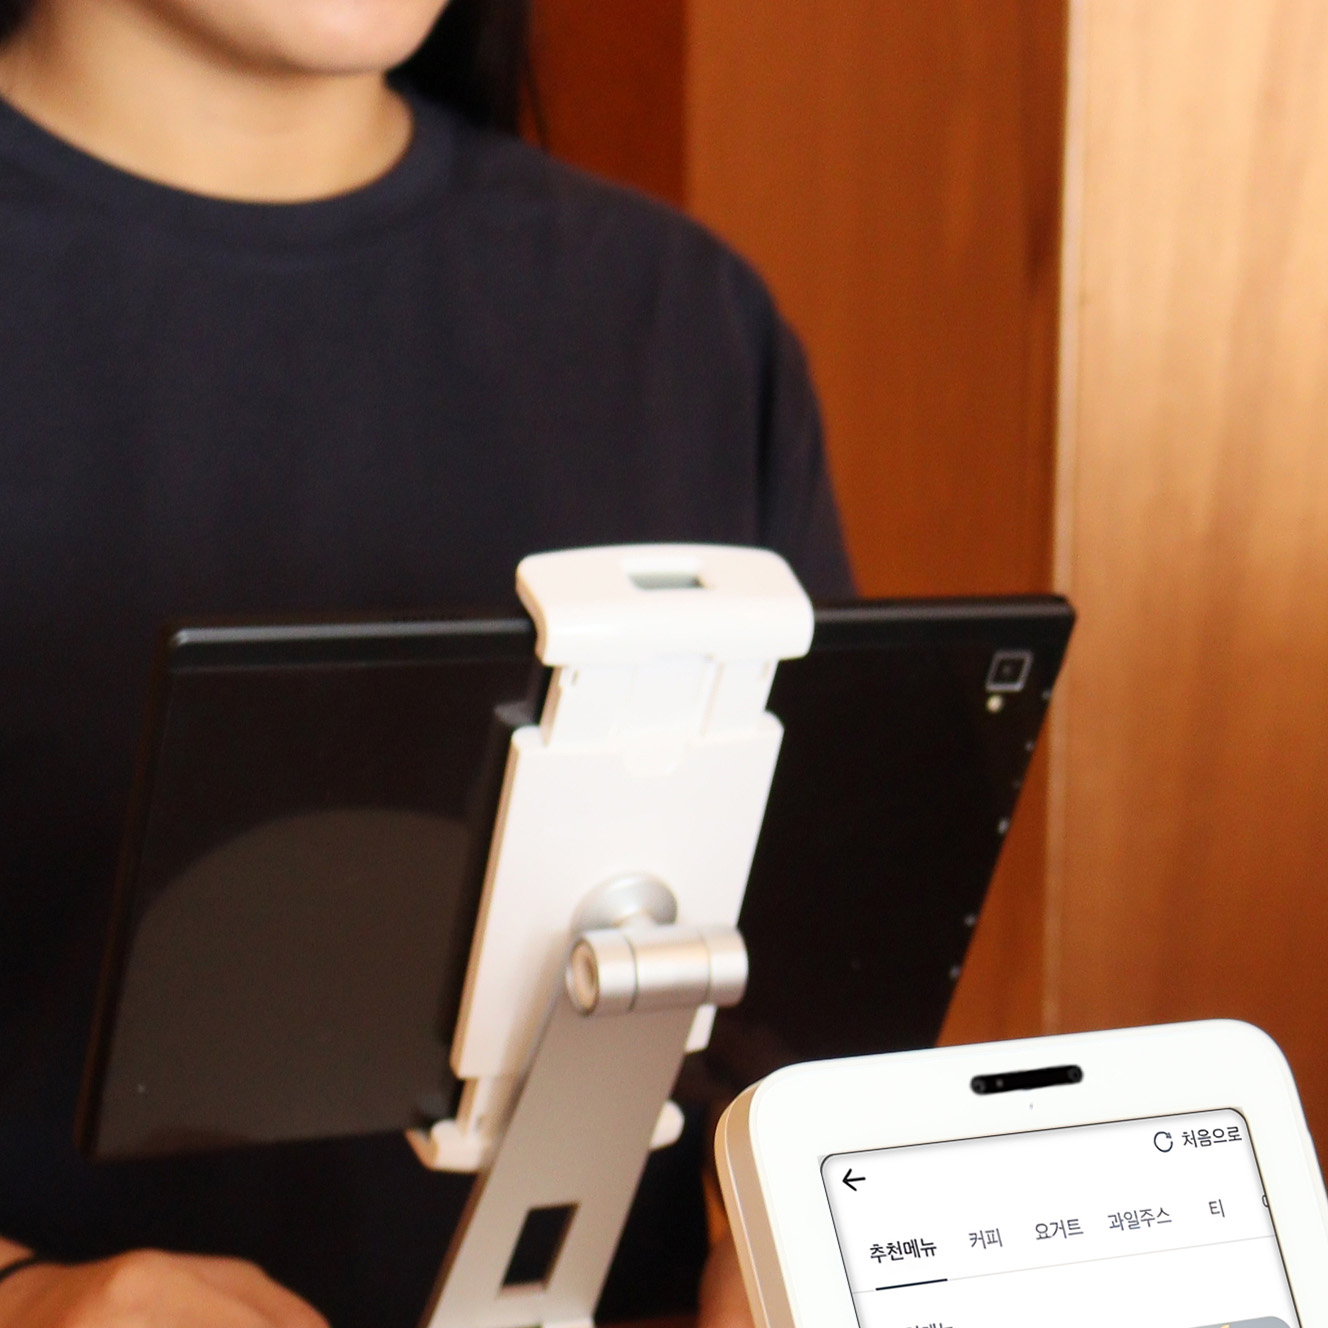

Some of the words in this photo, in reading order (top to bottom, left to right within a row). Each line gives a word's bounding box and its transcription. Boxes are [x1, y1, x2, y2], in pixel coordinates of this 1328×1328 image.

[1181, 1125, 1243, 1149] 처음으로
[869, 1237, 938, 1265] 추천메뉴
[968, 1227, 1003, 1251] 커피
[1034, 1217, 1084, 1242] 요거트
[1107, 1206, 1173, 1232] 과일주스
[1208, 1198, 1226, 1219] 티
